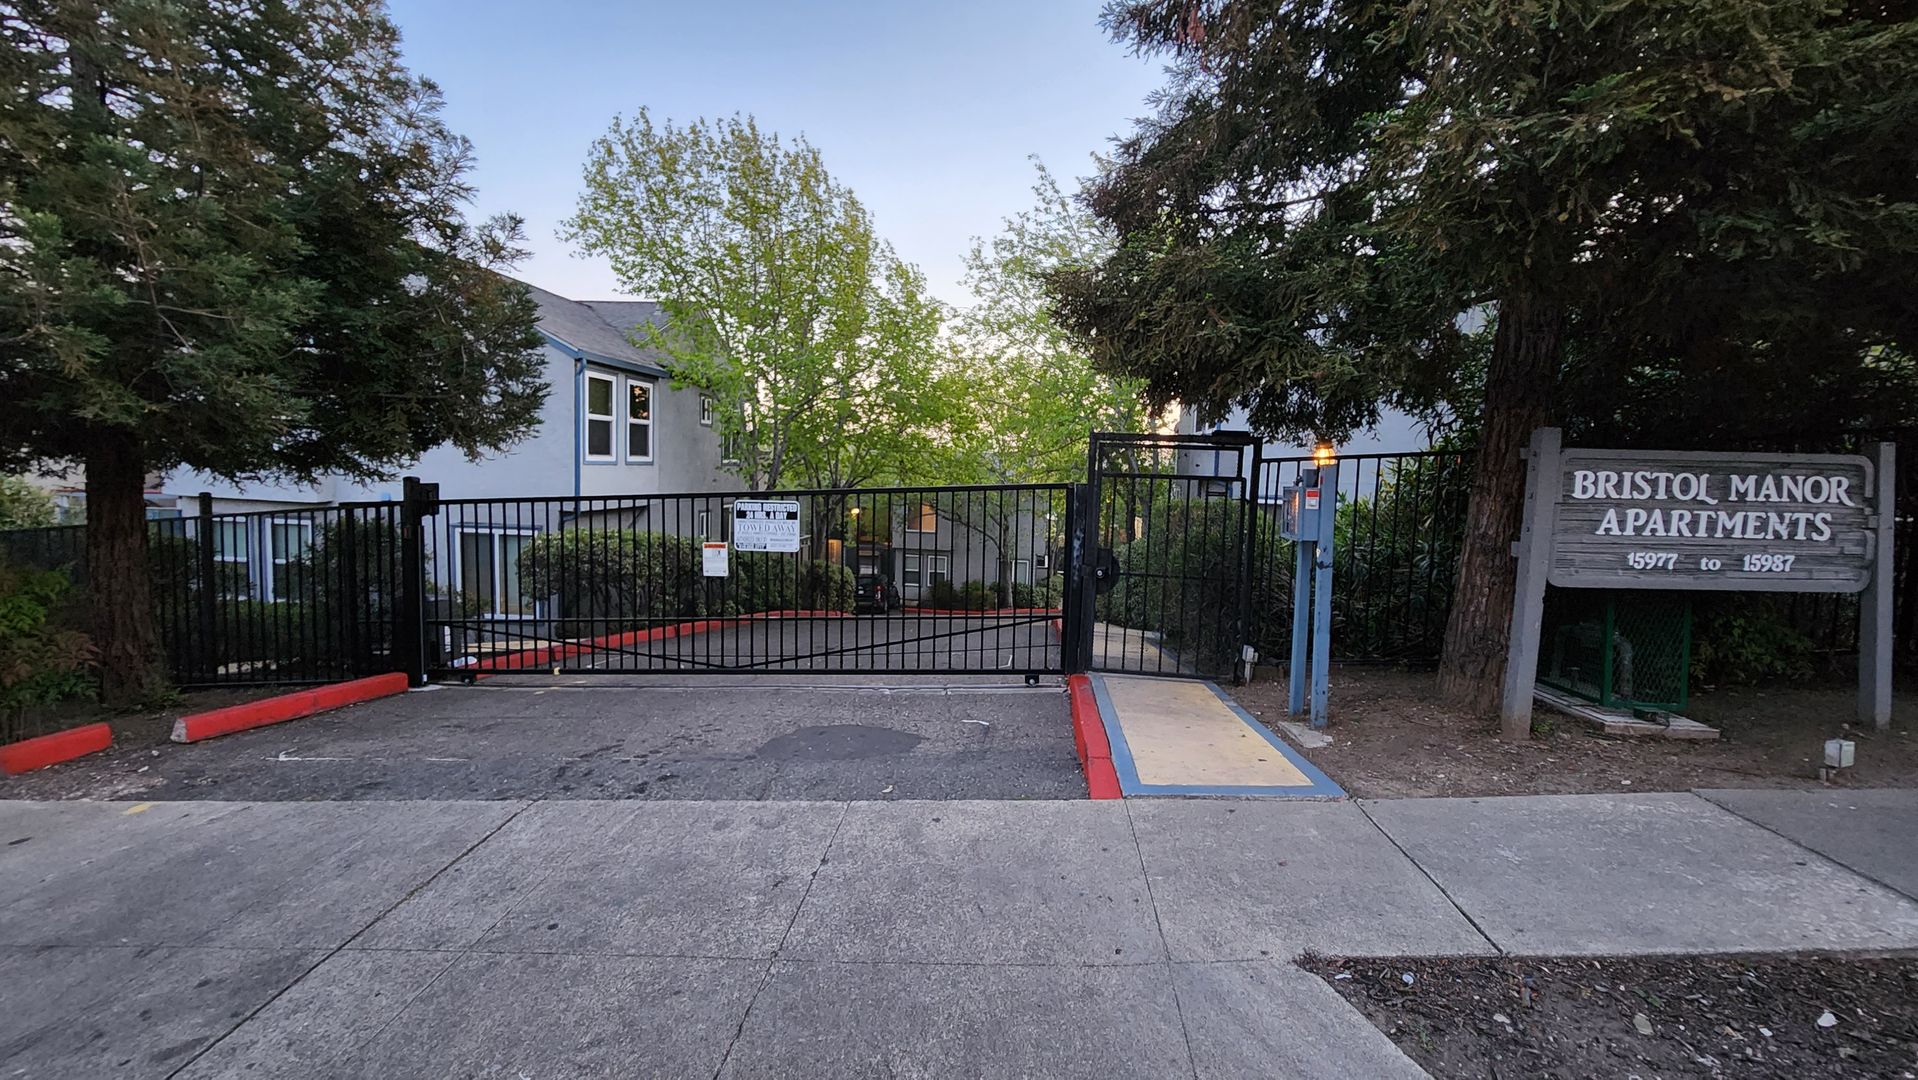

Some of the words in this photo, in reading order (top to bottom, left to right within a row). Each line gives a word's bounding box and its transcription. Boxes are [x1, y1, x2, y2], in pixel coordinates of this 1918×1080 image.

[1571, 470, 1718, 505] BRISTOL
[1727, 474, 1855, 506] MANOR
[736, 502, 762, 511] PARKING
[762, 503, 798, 512] RESTRICTED
[745, 511, 754, 519] 24
[769, 511, 775, 519] A
[775, 511, 788, 520] DAY
[738, 523, 771, 532] TOWED
[773, 524, 796, 533] AWAY
[1595, 508, 1832, 541] APARTMENTS
[1627, 552, 1678, 569] 15977
[1700, 556, 1721, 571] to
[1743, 554, 1795, 572] 15987
